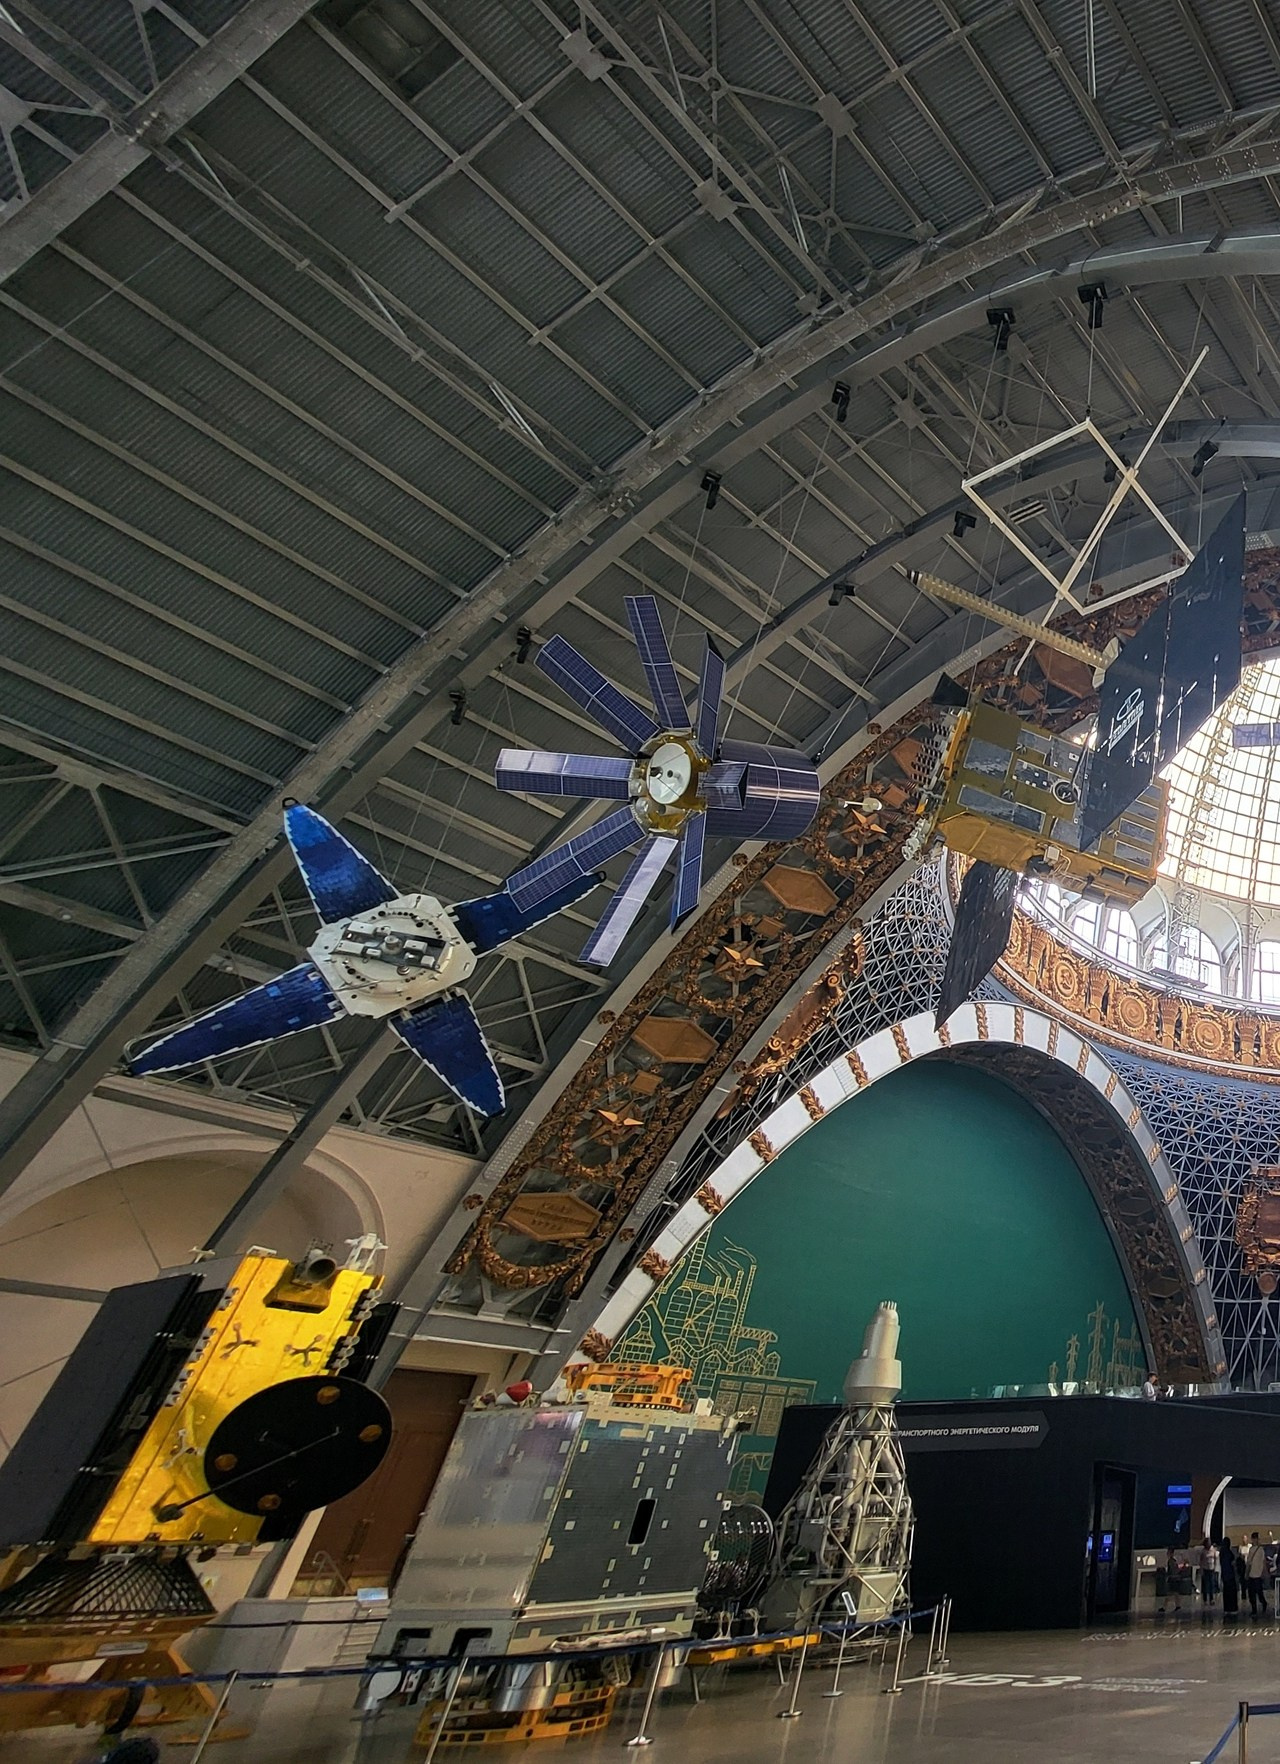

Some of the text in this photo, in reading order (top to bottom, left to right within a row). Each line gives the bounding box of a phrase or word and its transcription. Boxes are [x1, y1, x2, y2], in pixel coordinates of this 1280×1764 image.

[896, 1425, 1040, 1438] РАНСПОРТНОГО ЭНЕРГЕТИЧЕСКОГО МОДУЛЯ
